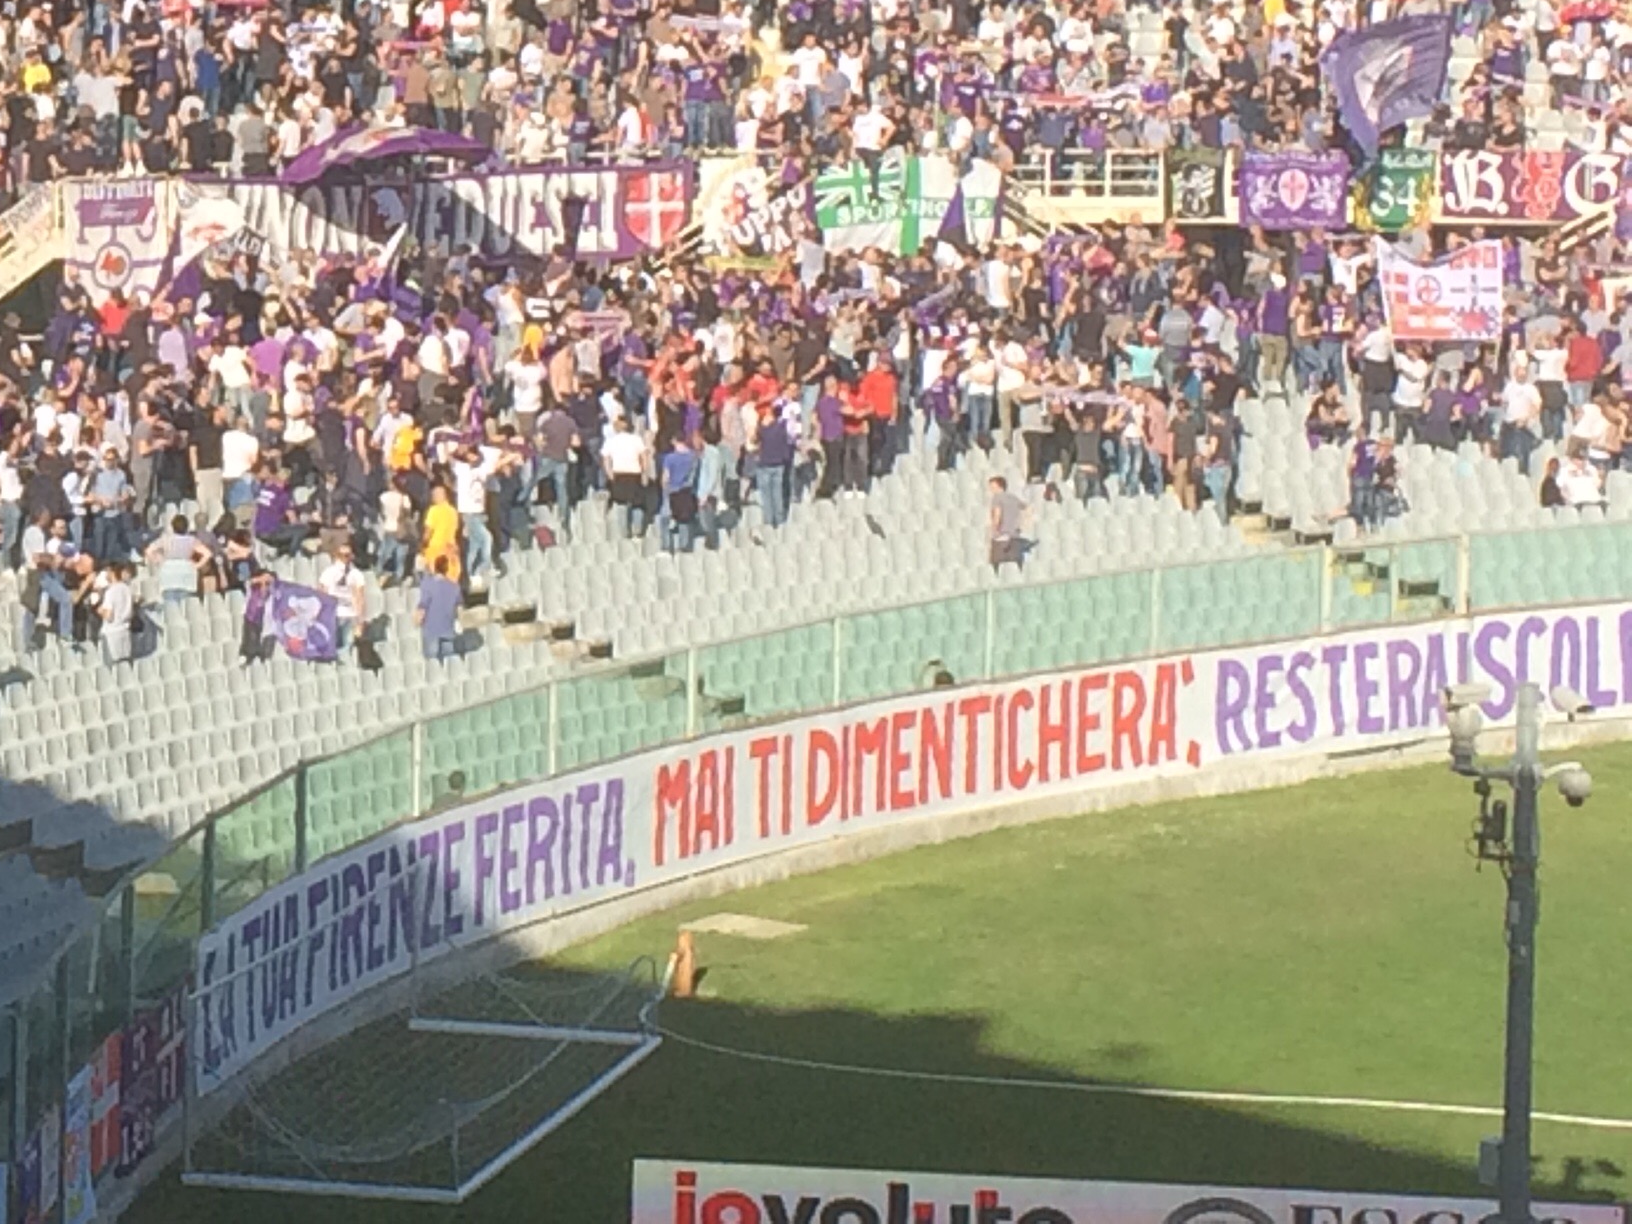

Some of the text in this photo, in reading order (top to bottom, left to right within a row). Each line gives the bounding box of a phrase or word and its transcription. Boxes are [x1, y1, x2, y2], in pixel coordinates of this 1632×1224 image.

[1370, 175, 1421, 218] 34
[304, 818, 467, 1008] FIRENZE
[652, 744, 735, 867] MAI
[748, 733, 792, 841] TI
